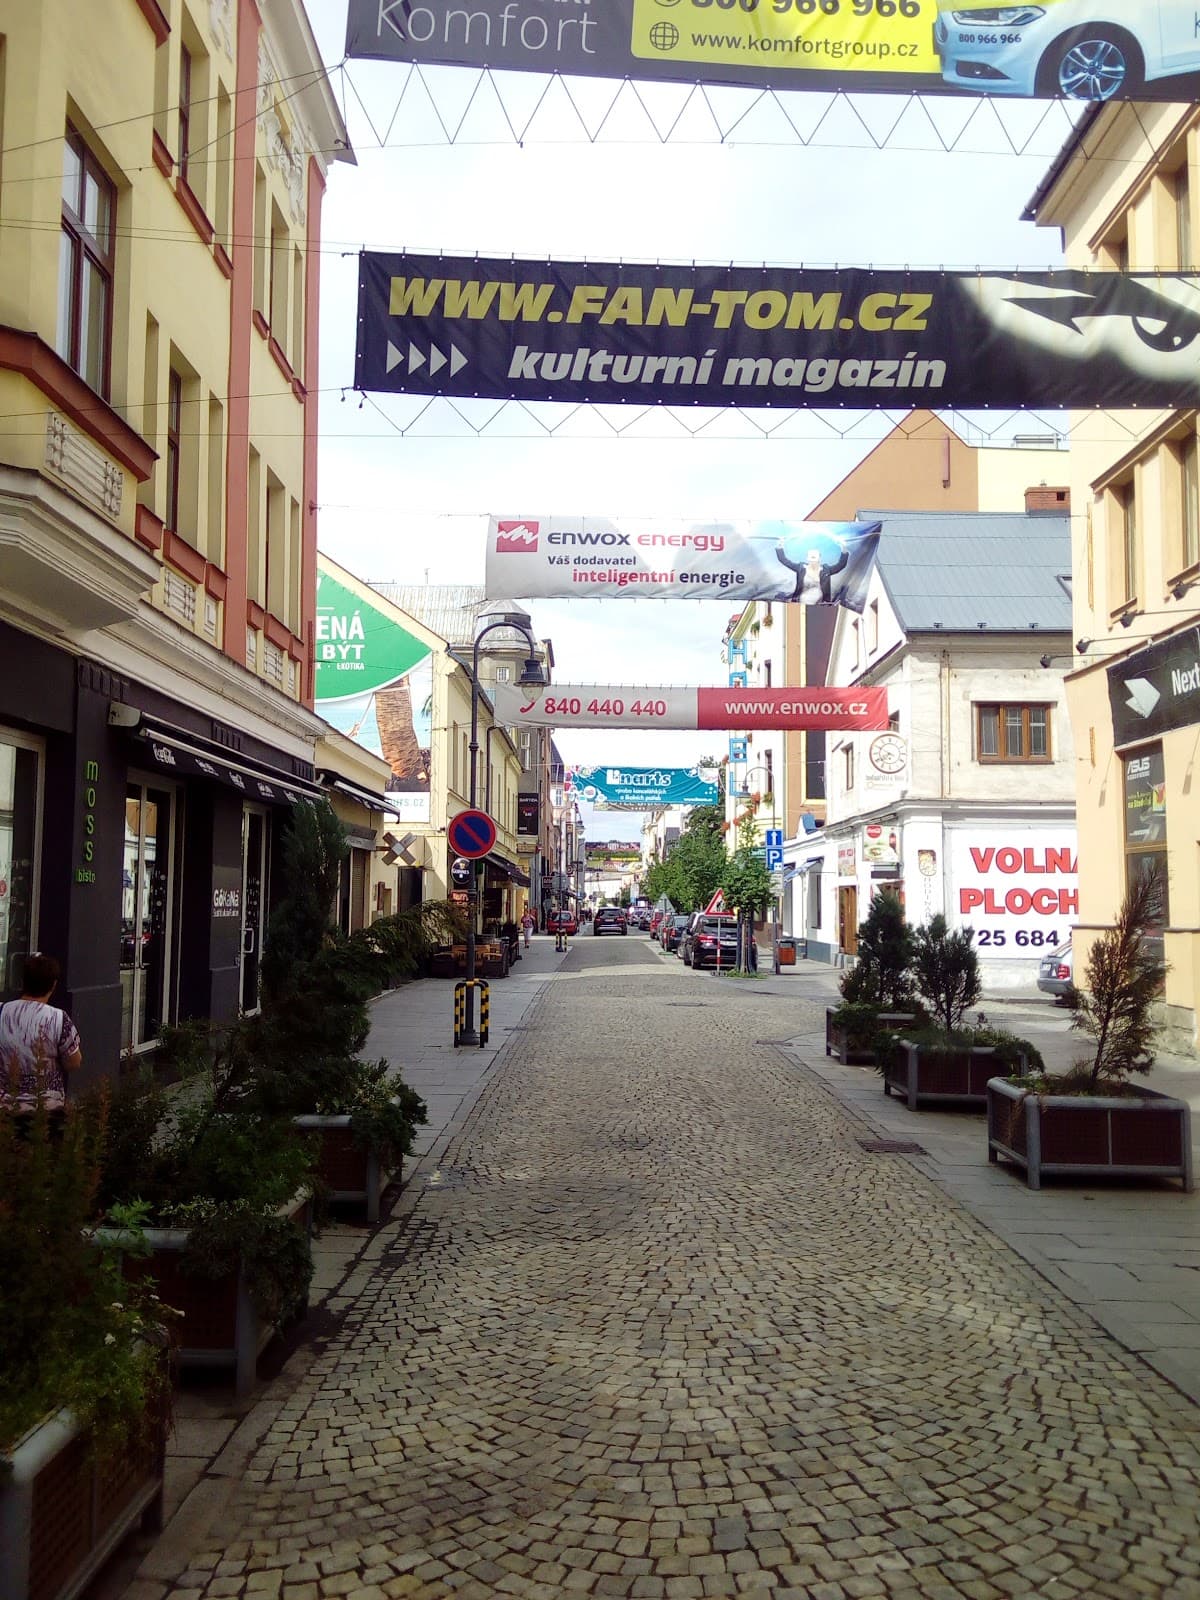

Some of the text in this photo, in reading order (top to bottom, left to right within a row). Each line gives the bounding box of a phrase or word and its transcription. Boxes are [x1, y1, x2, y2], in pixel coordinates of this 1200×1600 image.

[377, 0, 597, 53] Komfort
[691, 33, 918, 59] www.komfortgroup.cz
[959, 33, 1021, 44] 800 966 966
[388, 276, 932, 330] WWW.FAN-TOM.CZ
[508, 345, 946, 393] kulturní magazín
[547, 532, 725, 552] enwox energy
[547, 555, 637, 566] Váš dodavatel
[573, 569, 745, 586] inteligentní energie
[322, 641, 365, 660] BÝT
[544, 698, 667, 717] 840 440 440
[725, 700, 868, 716] www.enwox.cz
[1127, 757, 1150, 774] ASUS
[971, 930, 1006, 946] 25
[1015, 930, 1060, 946] 684
